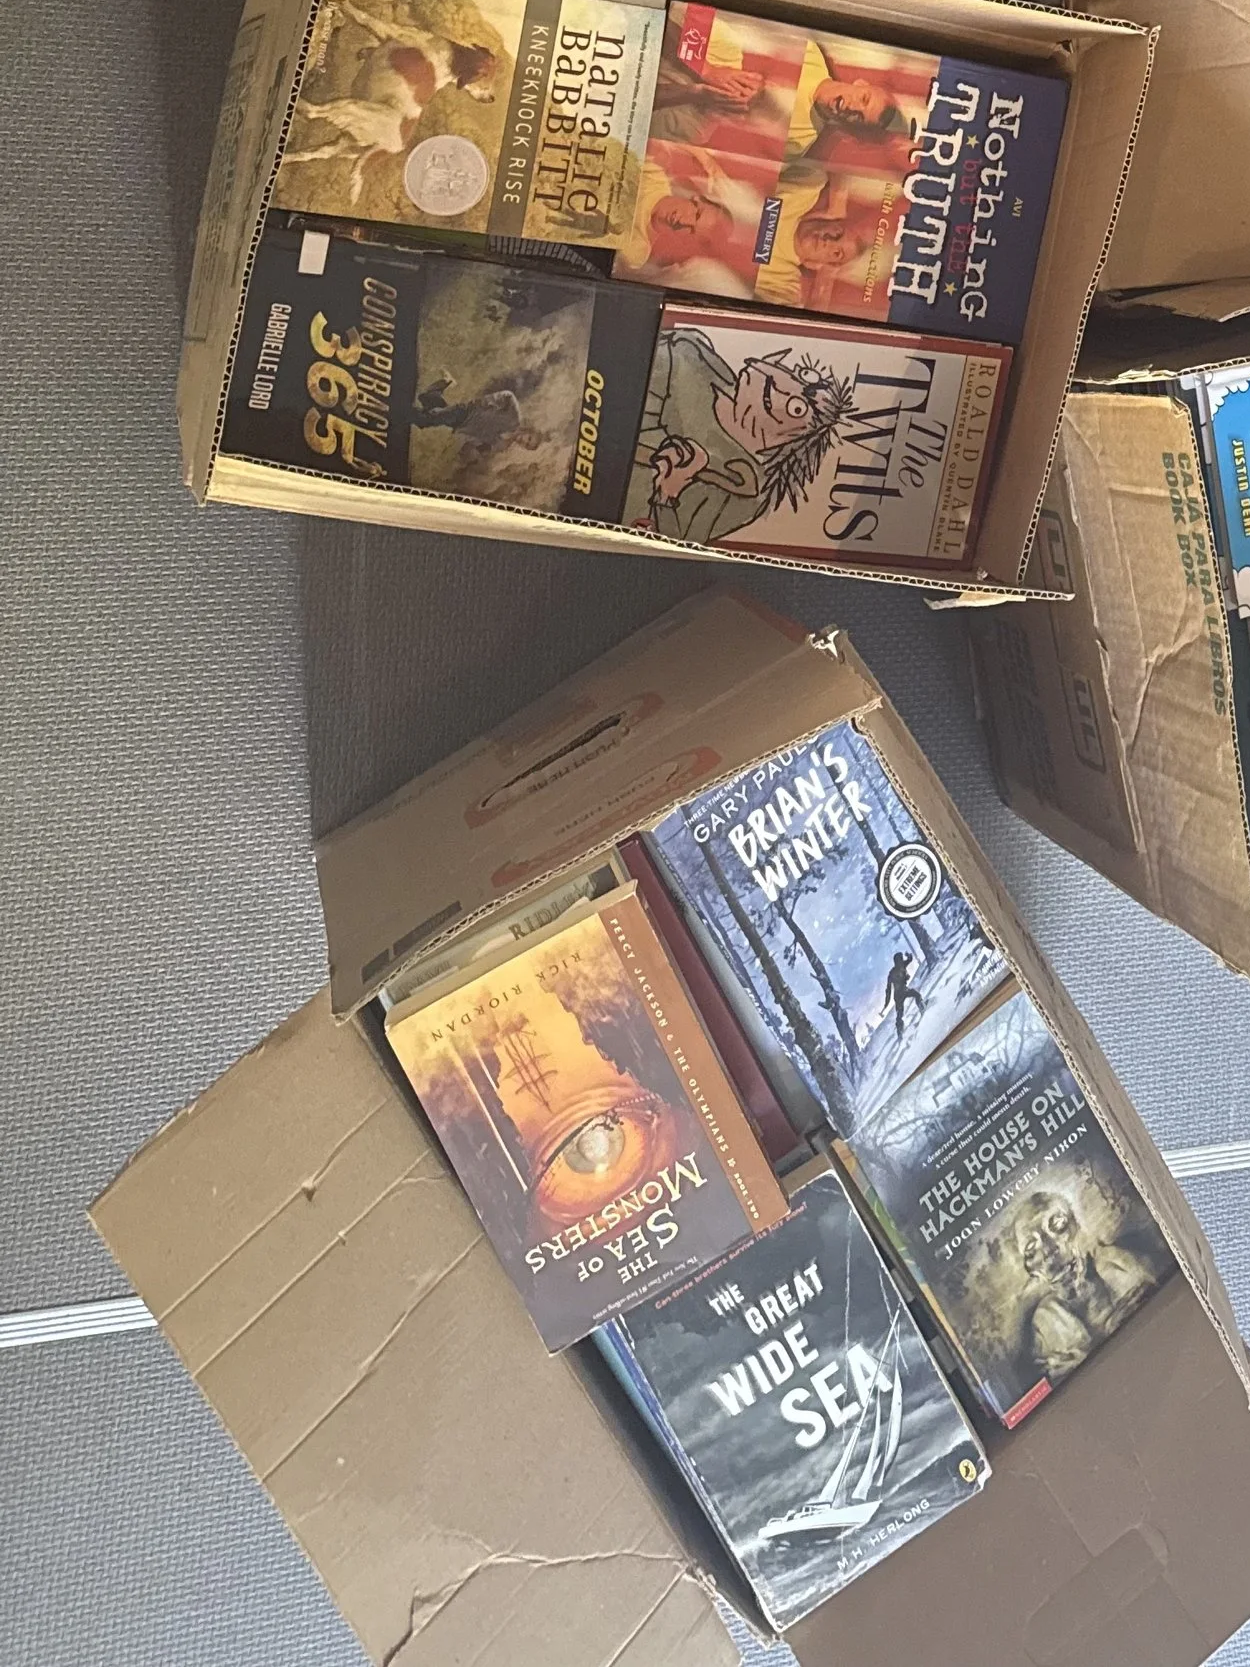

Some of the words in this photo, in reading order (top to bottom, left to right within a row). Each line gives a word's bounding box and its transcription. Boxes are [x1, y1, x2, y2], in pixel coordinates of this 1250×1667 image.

[510, 24, 550, 148] KNEEKNOCK
[502, 156, 528, 206] RISE
[881, 182, 895, 215] with
[887, 76, 981, 306] TRUTH
[960, 158, 983, 214] but
[1012, 196, 1024, 218] AVI
[753, 197, 781, 264] NEWBERY
[861, 218, 890, 304] Connections
[946, 223, 978, 274] the
[260, 302, 292, 378] GABRIELLE
[352, 276, 398, 449] CONSPIRACY
[248, 381, 274, 410] LORD
[303, 310, 364, 462] 365
[955, 361, 976, 439] ILLUSTRATED
[959, 362, 997, 461] ROALD
[572, 368, 606, 496] OCTOBER
[896, 415, 949, 490] The
[1231, 438, 1250, 490] JUSTIN
[941, 461, 957, 516] QUENTIN
[942, 472, 976, 555] DAHL
[1160, 451, 1187, 526] BOOK
[1175, 534, 1198, 590] BOX
[1175, 451, 1202, 527] CAJA
[932, 516, 948, 554] BLAKE
[1192, 531, 1218, 611] PARA
[1201, 614, 1228, 717] LIBROS
[683, 789, 727, 828] THREE-TIME
[693, 784, 751, 843] GARY
[728, 742, 849, 869] BRIAN'S
[751, 780, 873, 902] WINTER
[898, 866, 921, 894] EXTREME
[537, 947, 583, 983] RICK
[429, 984, 522, 1045] RIORDAN
[608, 917, 638, 961] PERCY
[633, 966, 670, 1029] JACKSON
[672, 1046, 692, 1072] THE
[687, 1075, 731, 1153] OLYMPIANS
[732, 1171, 750, 1202] BOOK
[745, 1198, 761, 1222] TWO
[917, 1130, 1039, 1245] HACKMAN'S
[1040, 1092, 1087, 1145] HILL
[919, 1171, 962, 1215] THE
[965, 1109, 1030, 1177] HOUSE
[1030, 1081, 1067, 1121] ON
[1042, 1121, 1090, 1166] NIXON
[524, 1150, 709, 1277] MONSTERS
[609, 1206, 681, 1269] SEA
[575, 1254, 606, 1285] OF
[616, 1249, 660, 1285] THE
[708, 1282, 745, 1317] THE
[745, 1262, 827, 1335] GREAT
[709, 1322, 820, 1418] WIDE
[779, 1342, 894, 1449] SEA
[867, 1497, 932, 1548] HERLONG
